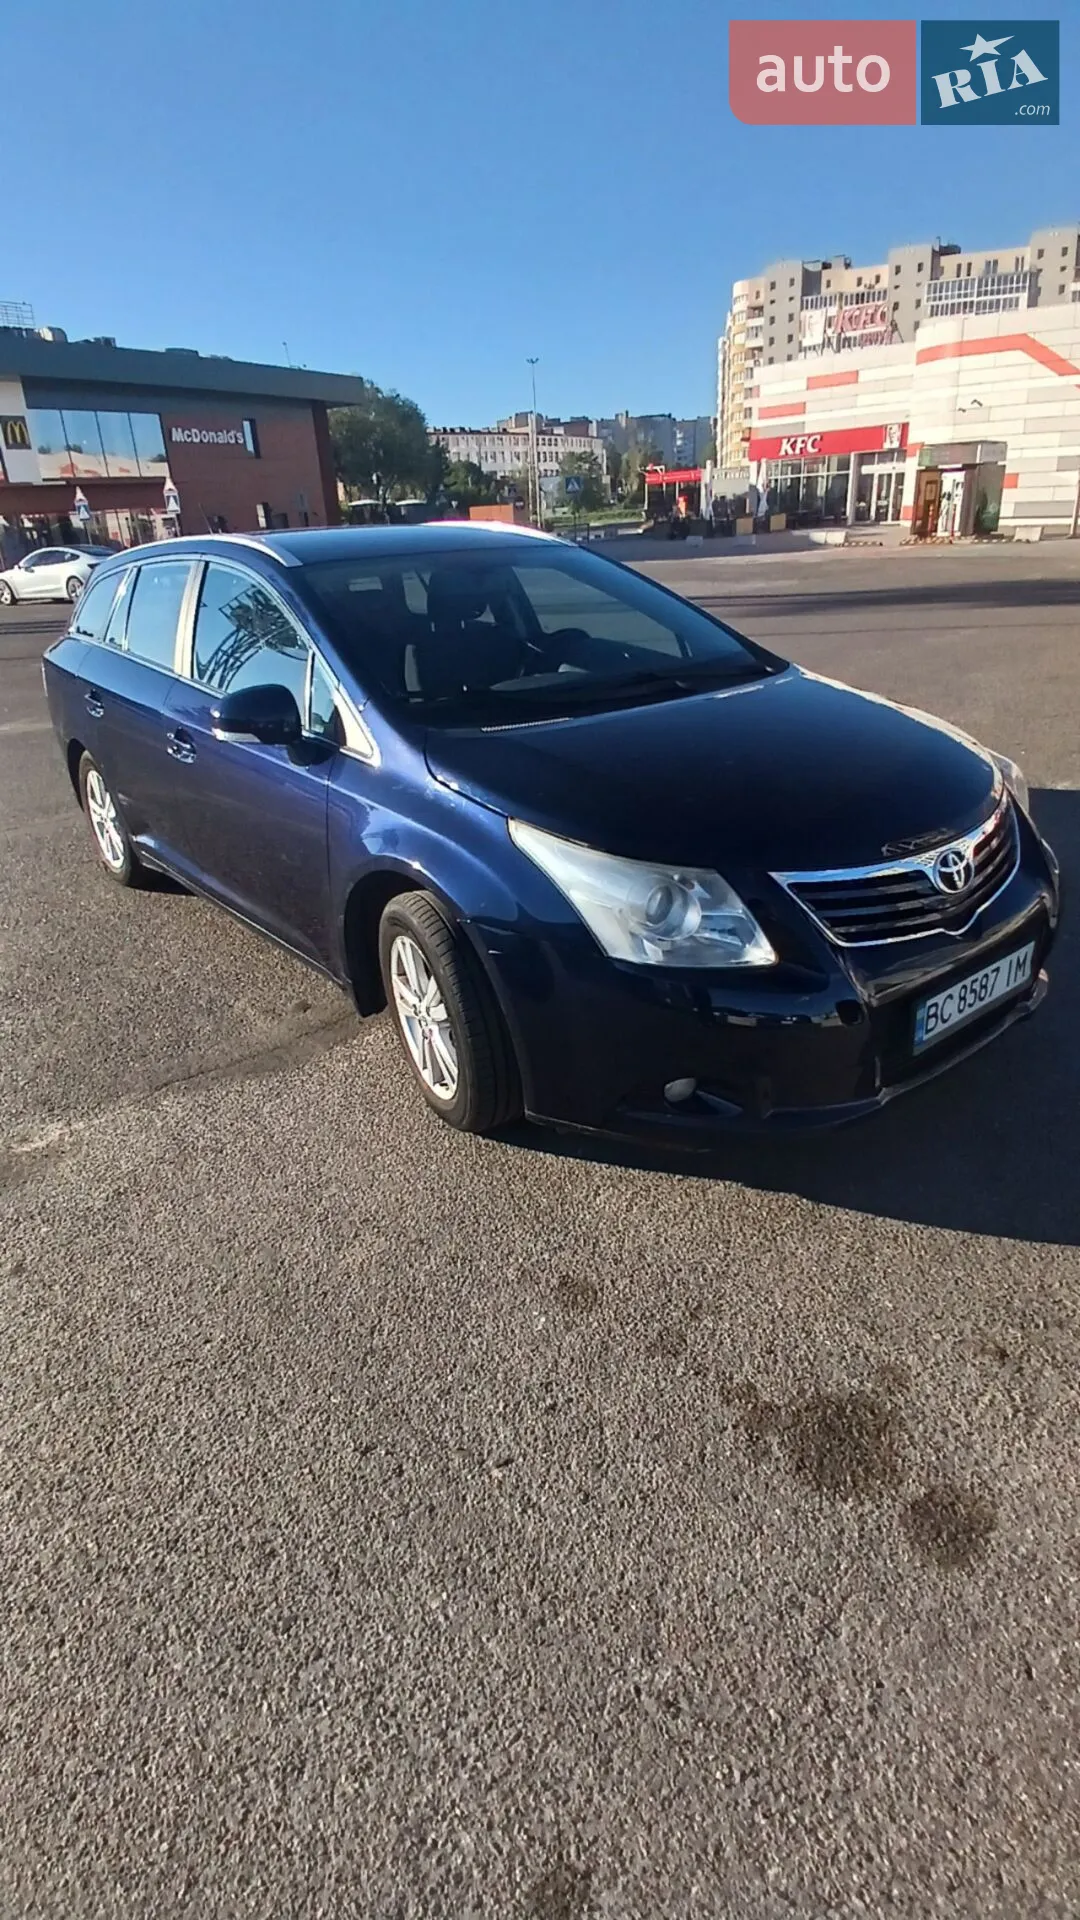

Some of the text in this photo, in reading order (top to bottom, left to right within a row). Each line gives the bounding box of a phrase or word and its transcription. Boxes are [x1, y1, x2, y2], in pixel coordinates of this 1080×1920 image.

[171, 427, 244, 444] McDonald's
[779, 434, 822, 456] KFC
[925, 951, 1028, 1035] BC 8587 IM
